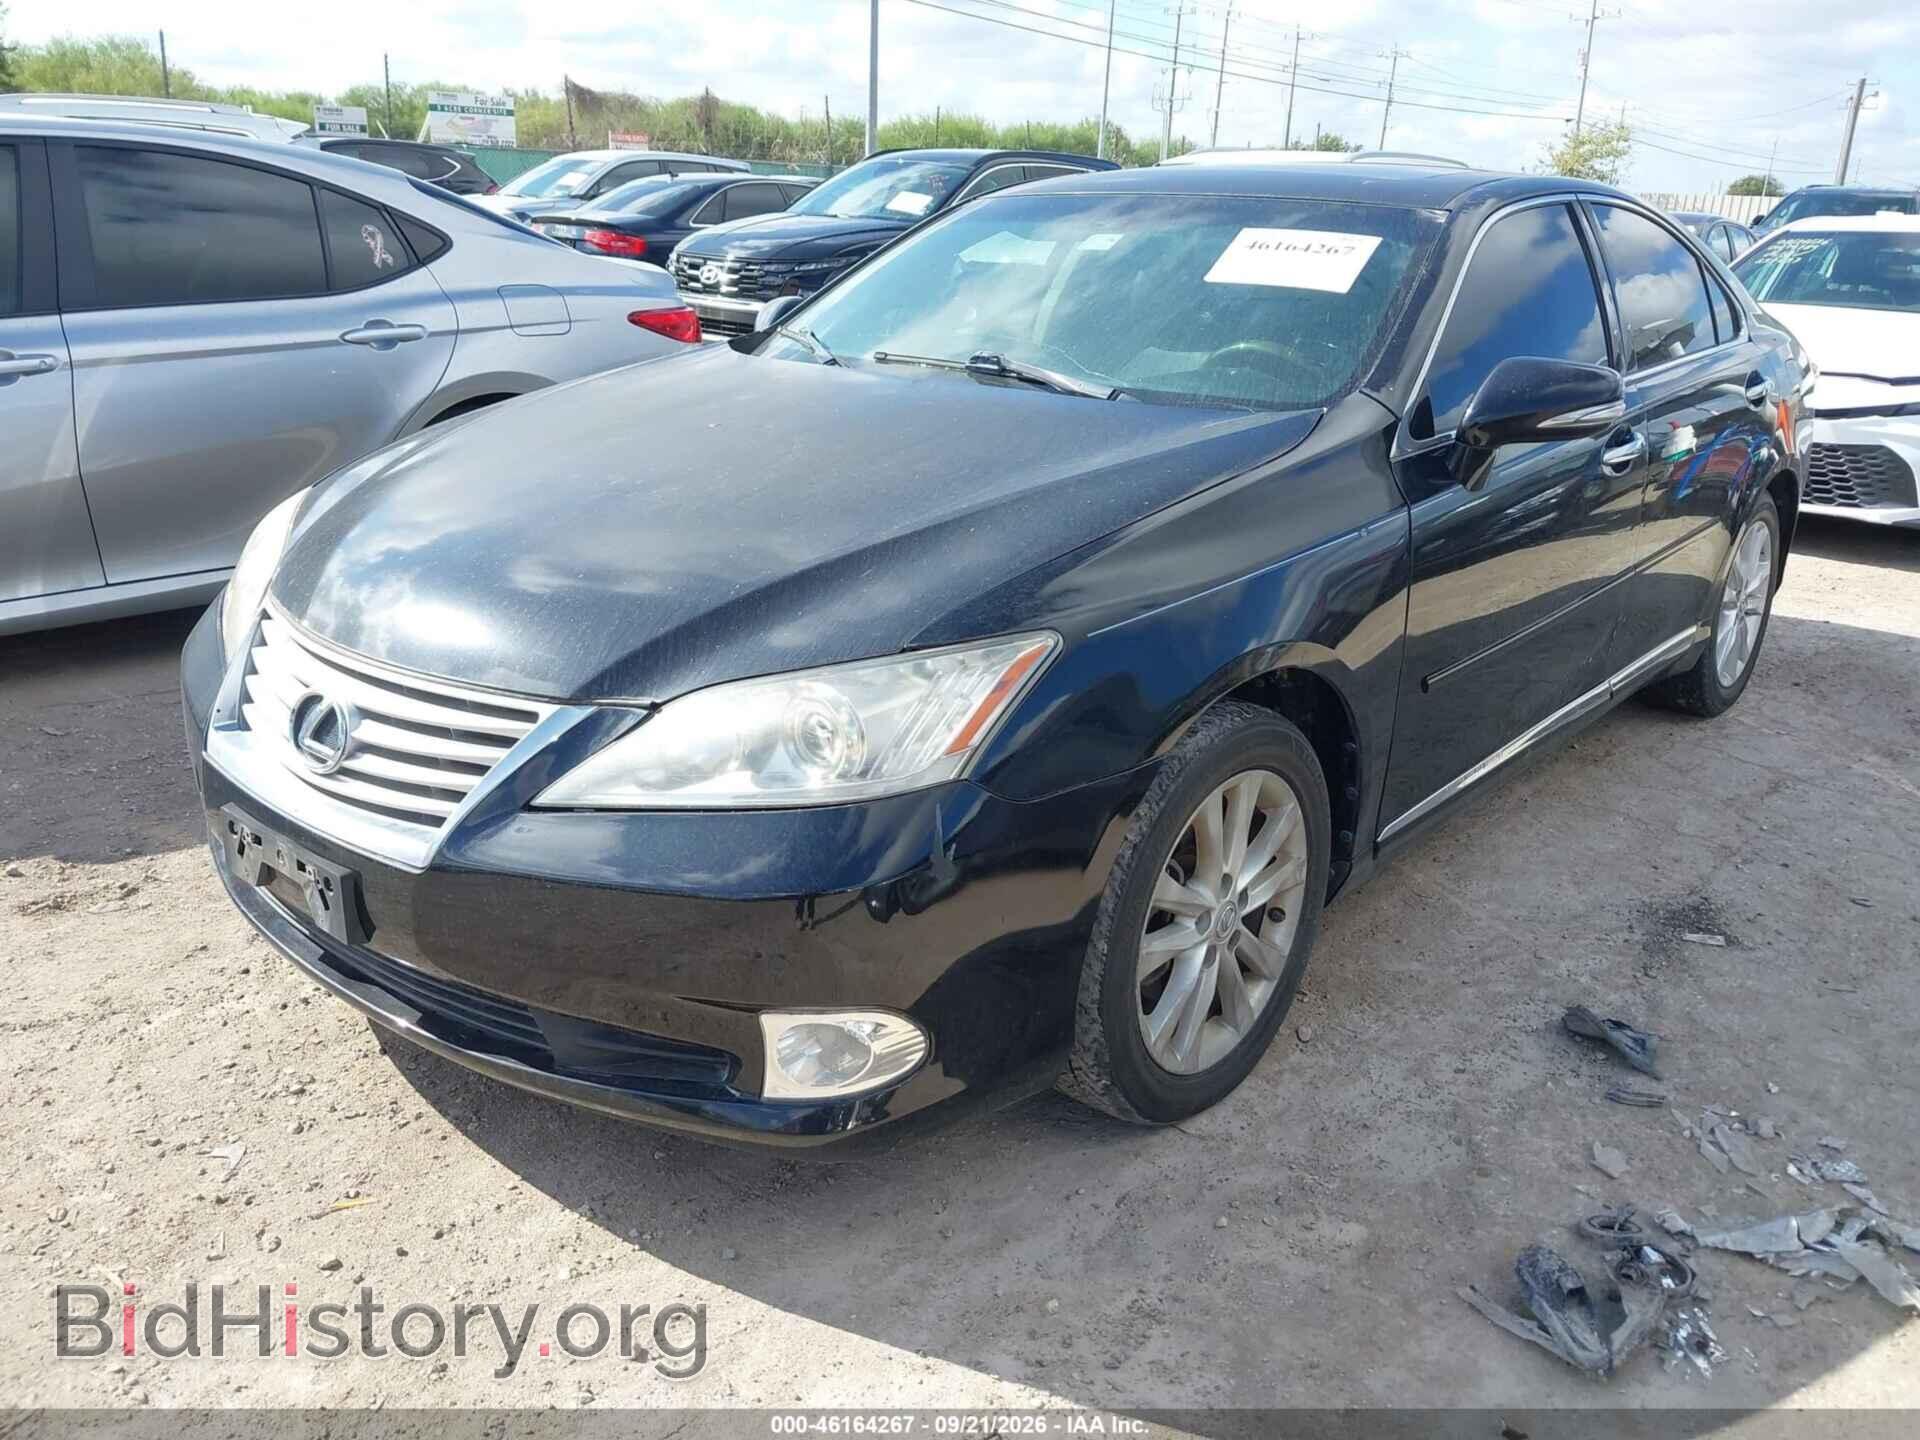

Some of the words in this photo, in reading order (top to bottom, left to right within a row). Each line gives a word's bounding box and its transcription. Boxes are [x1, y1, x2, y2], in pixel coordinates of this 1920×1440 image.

[474, 96, 488, 106] For
[490, 97, 506, 107] Sale
[1245, 239, 1357, 256] 46164267
